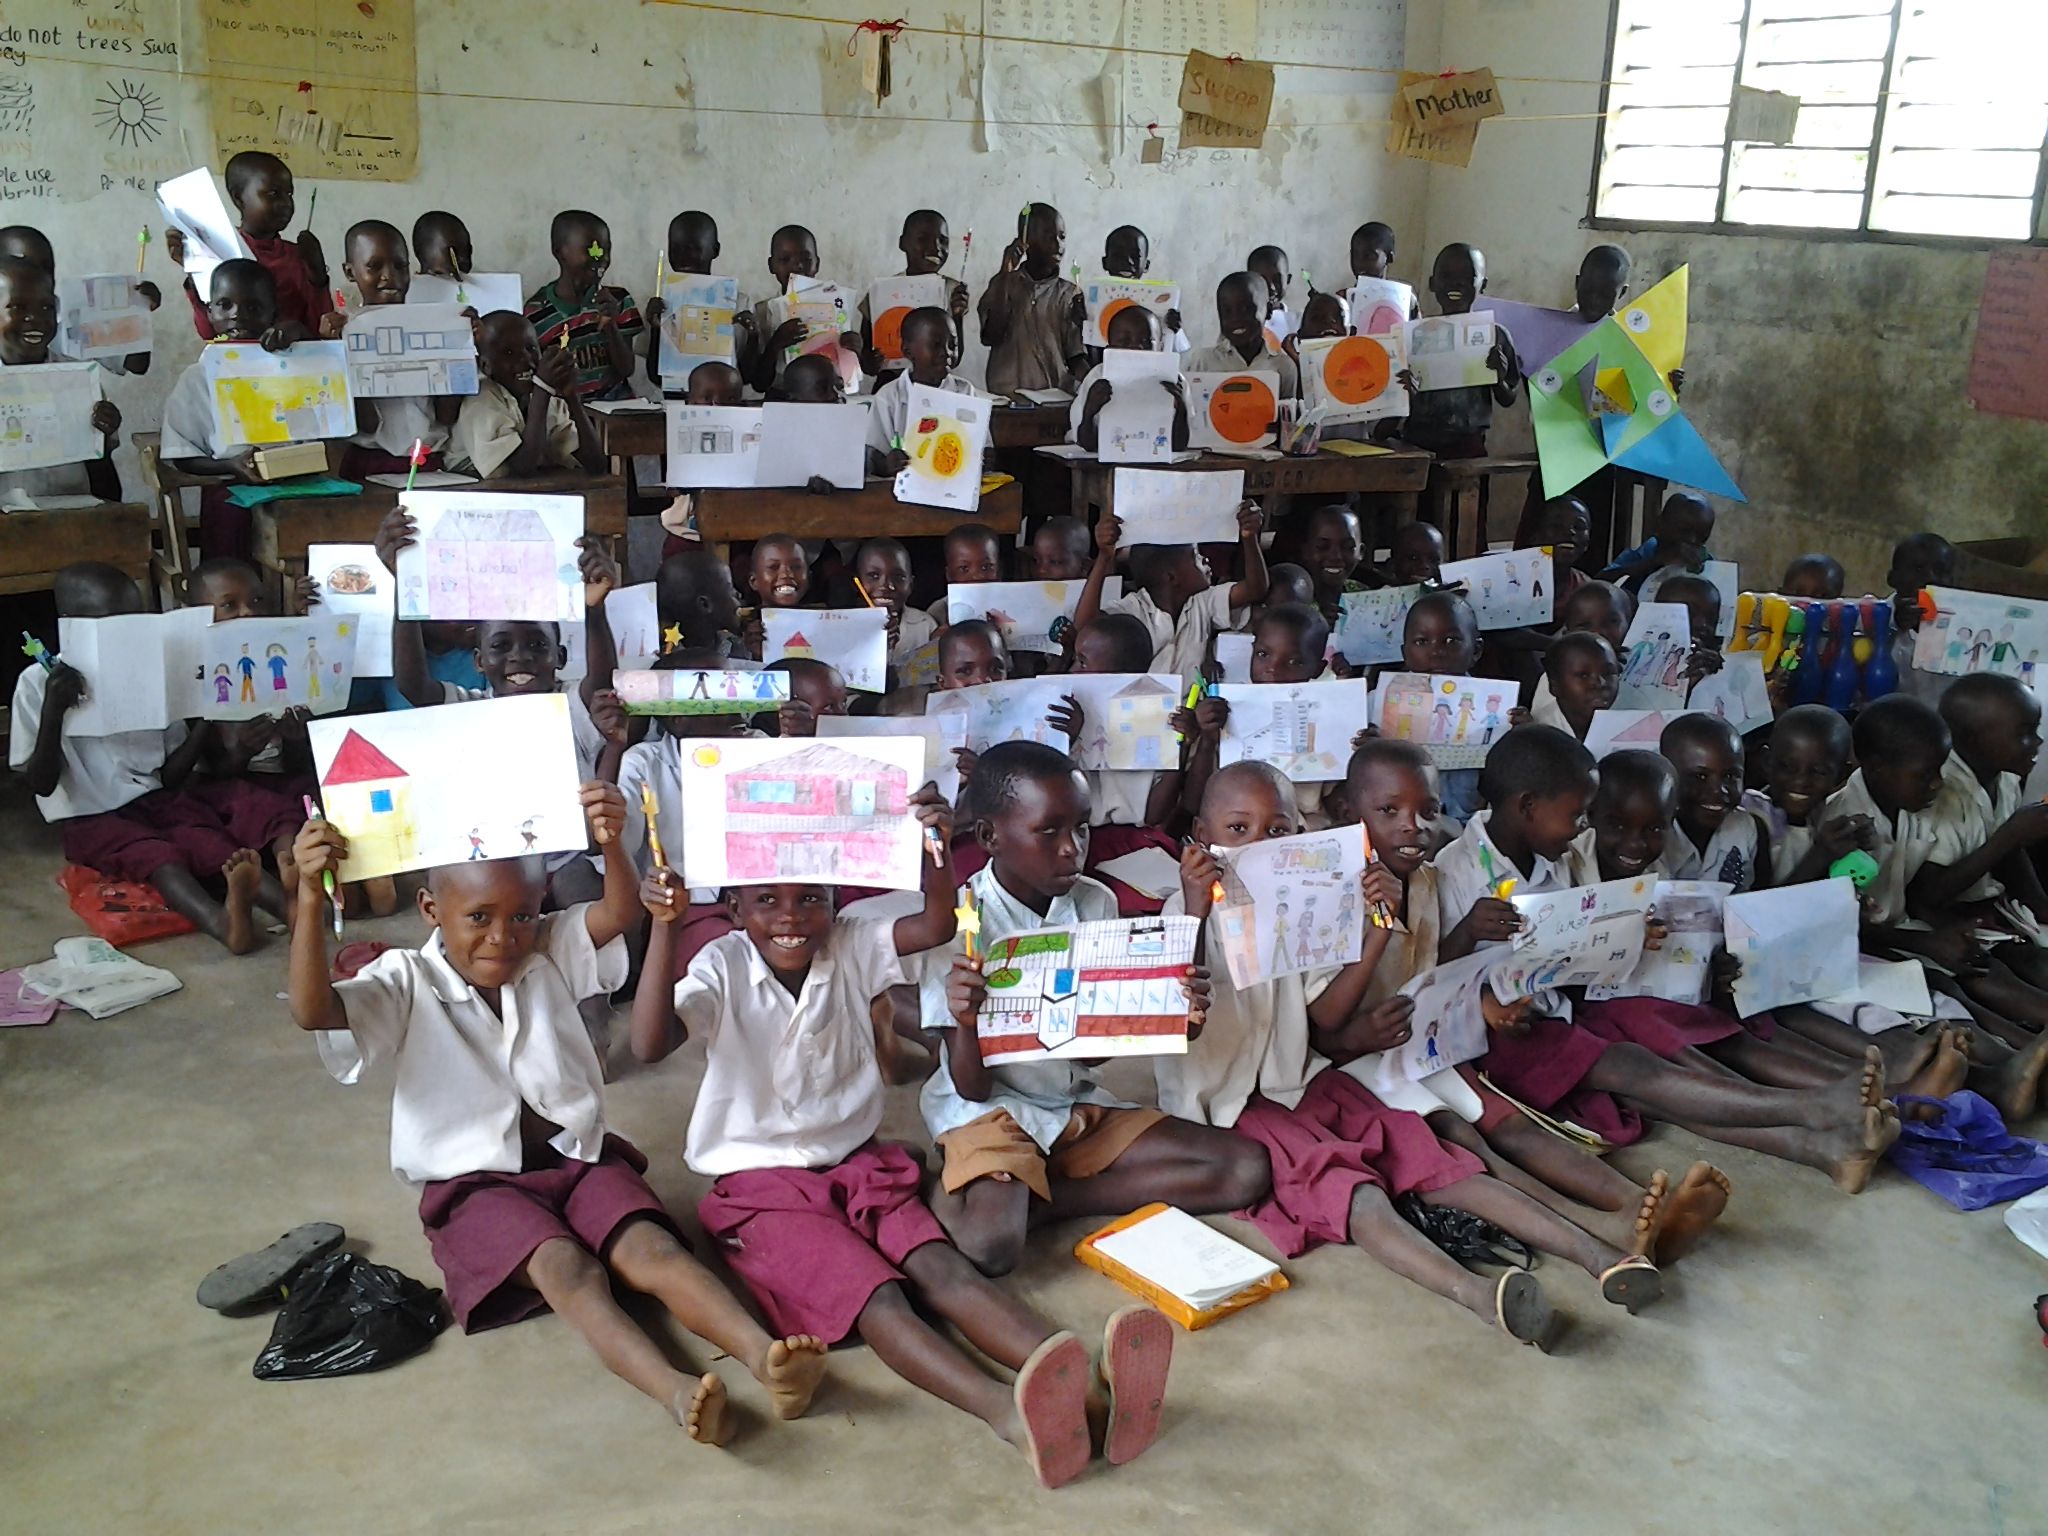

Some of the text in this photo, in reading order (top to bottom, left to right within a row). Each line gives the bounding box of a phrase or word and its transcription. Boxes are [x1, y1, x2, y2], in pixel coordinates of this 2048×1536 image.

[29, 26, 62, 46] not
[77, 31, 133, 53] trees
[1415, 87, 1493, 120] Mother
[25, 169, 56, 184] use
